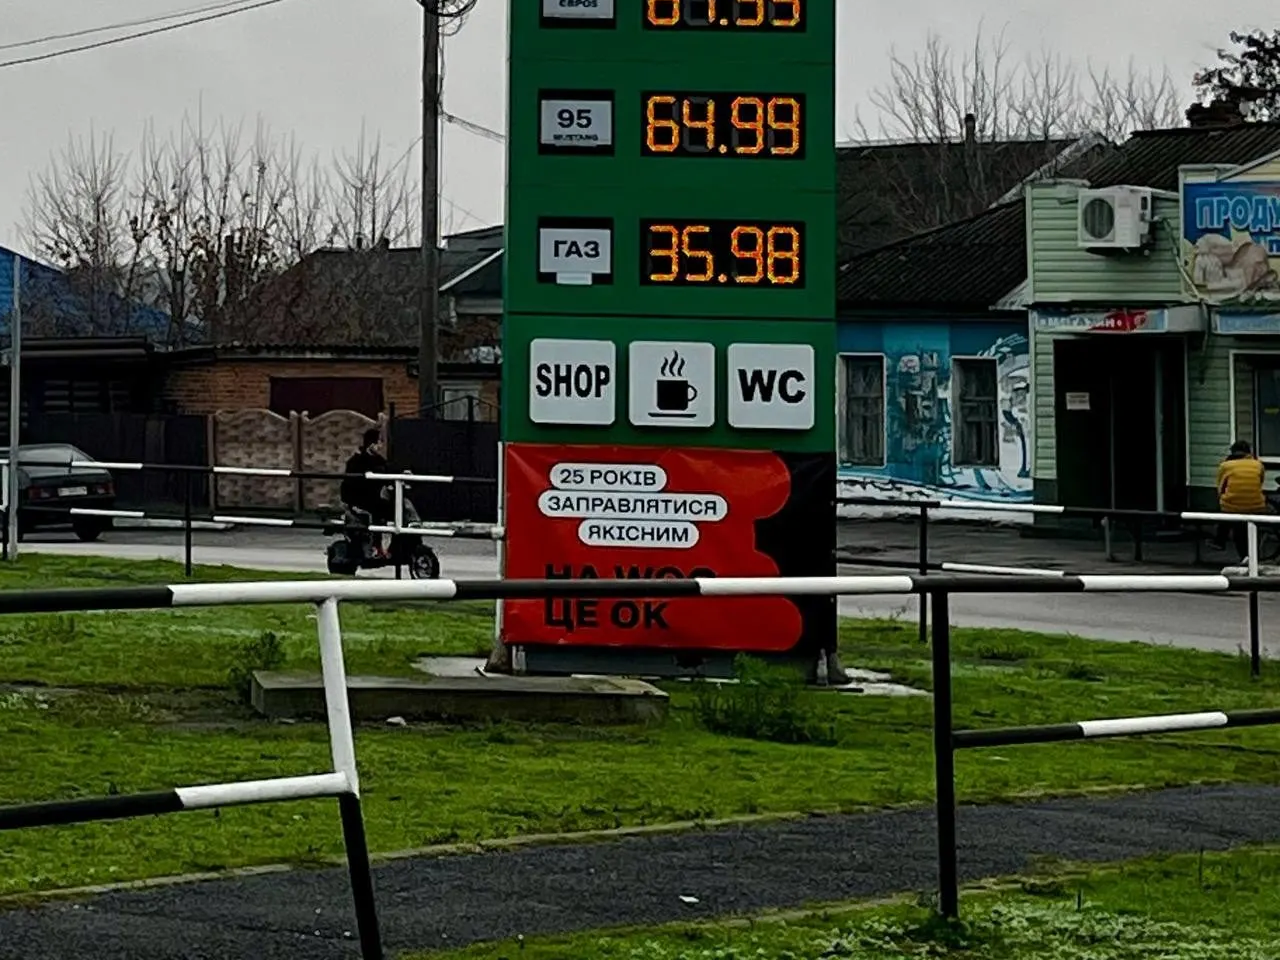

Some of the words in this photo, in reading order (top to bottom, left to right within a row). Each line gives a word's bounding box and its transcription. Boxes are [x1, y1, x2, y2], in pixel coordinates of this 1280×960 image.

[557, 108, 592, 129] 95
[646, 96, 800, 155] 64.99
[553, 239, 600, 258] ГАЗ
[647, 225, 800, 284] 35.98
[535, 363, 611, 398] SHOP
[738, 369, 807, 404] WC
[560, 468, 585, 485] 25
[590, 469, 657, 487] РОКІВ
[547, 495, 718, 516] ЗАПРАВЛЯТИСЯ
[588, 524, 690, 543] ЯКІСНИМ
[544, 597, 598, 632] ЦЕ
[610, 599, 671, 629] ОК
